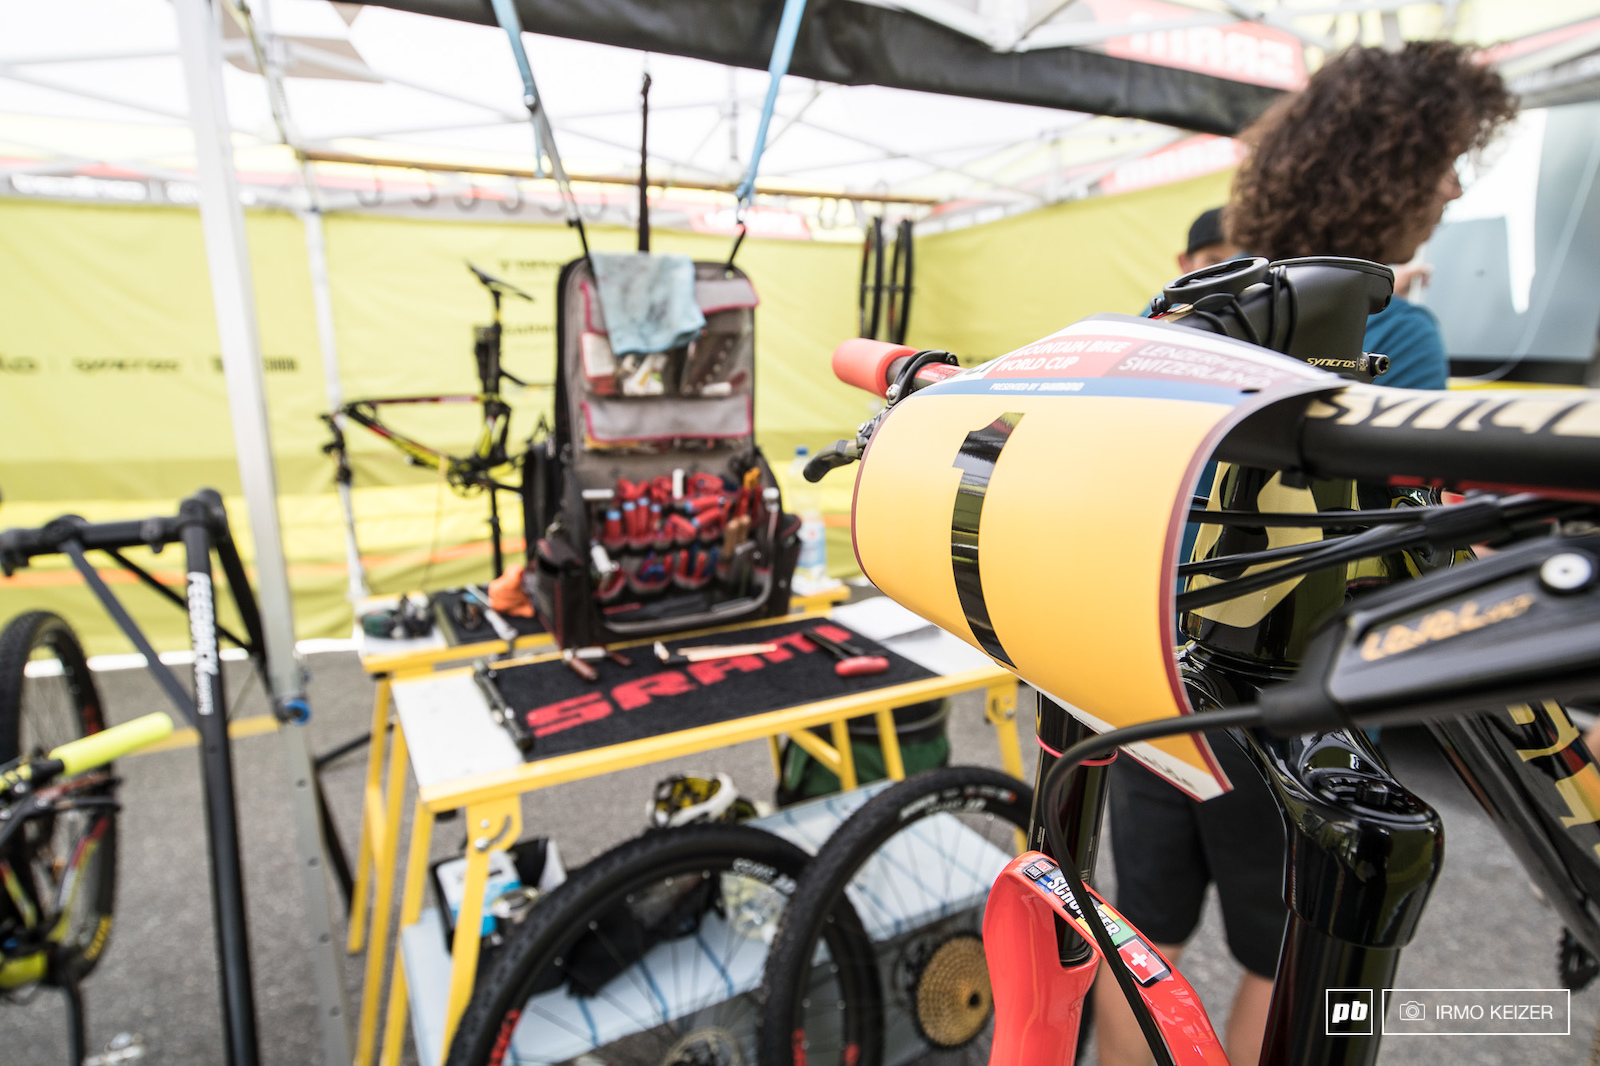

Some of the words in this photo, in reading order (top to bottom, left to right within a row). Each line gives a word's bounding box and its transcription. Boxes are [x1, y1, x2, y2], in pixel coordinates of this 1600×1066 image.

[1011, 340, 1089, 358] MOUNTAIN
[1086, 340, 1132, 354] BIKE
[996, 357, 1047, 371] WORLD
[1044, 356, 1080, 370] CUP
[989, 383, 1030, 391] PRESENTED
[951, 411, 1026, 671] 1
[1046, 876, 1122, 937] SCHUTER
